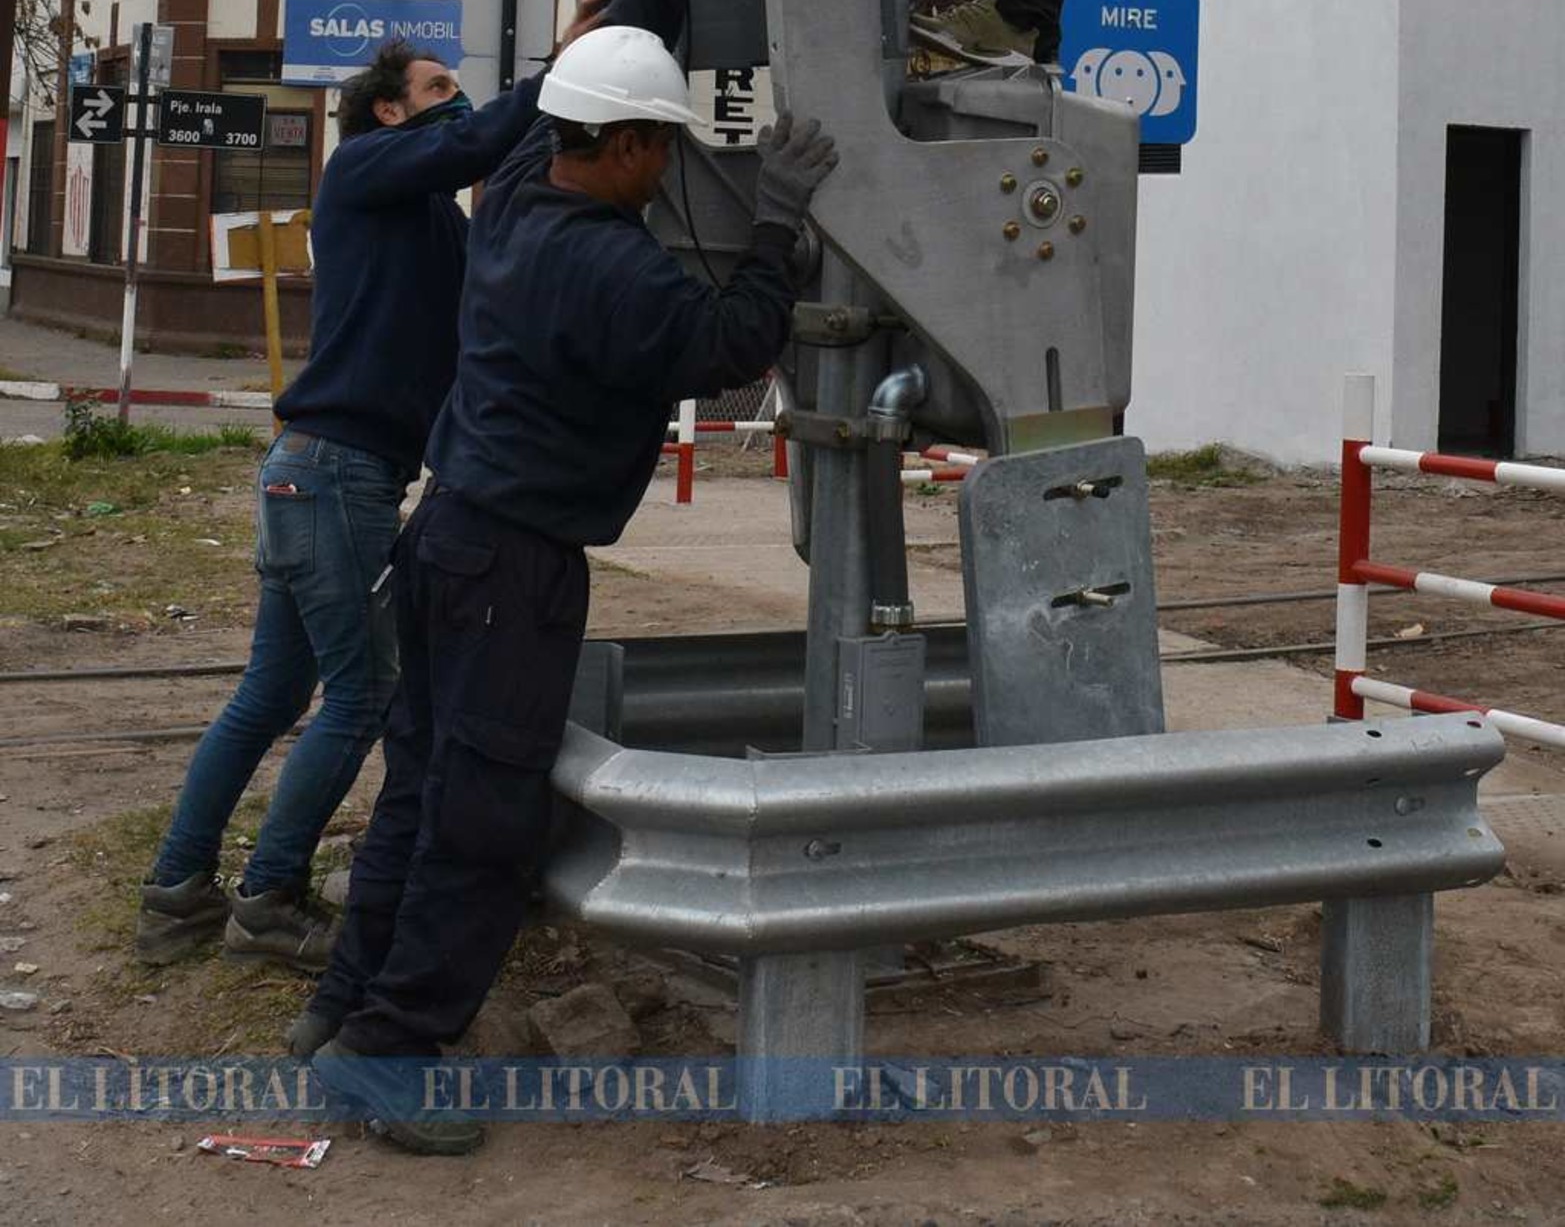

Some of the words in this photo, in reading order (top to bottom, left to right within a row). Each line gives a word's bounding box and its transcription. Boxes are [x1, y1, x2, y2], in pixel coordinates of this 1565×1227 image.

[1101, 6, 1158, 29] MIRE
[310, 19, 384, 38] SALAS
[170, 101, 193, 115] Pje.
[196, 102, 222, 114] Irala
[169, 130, 200, 143] 3600
[226, 132, 258, 145] 3700
